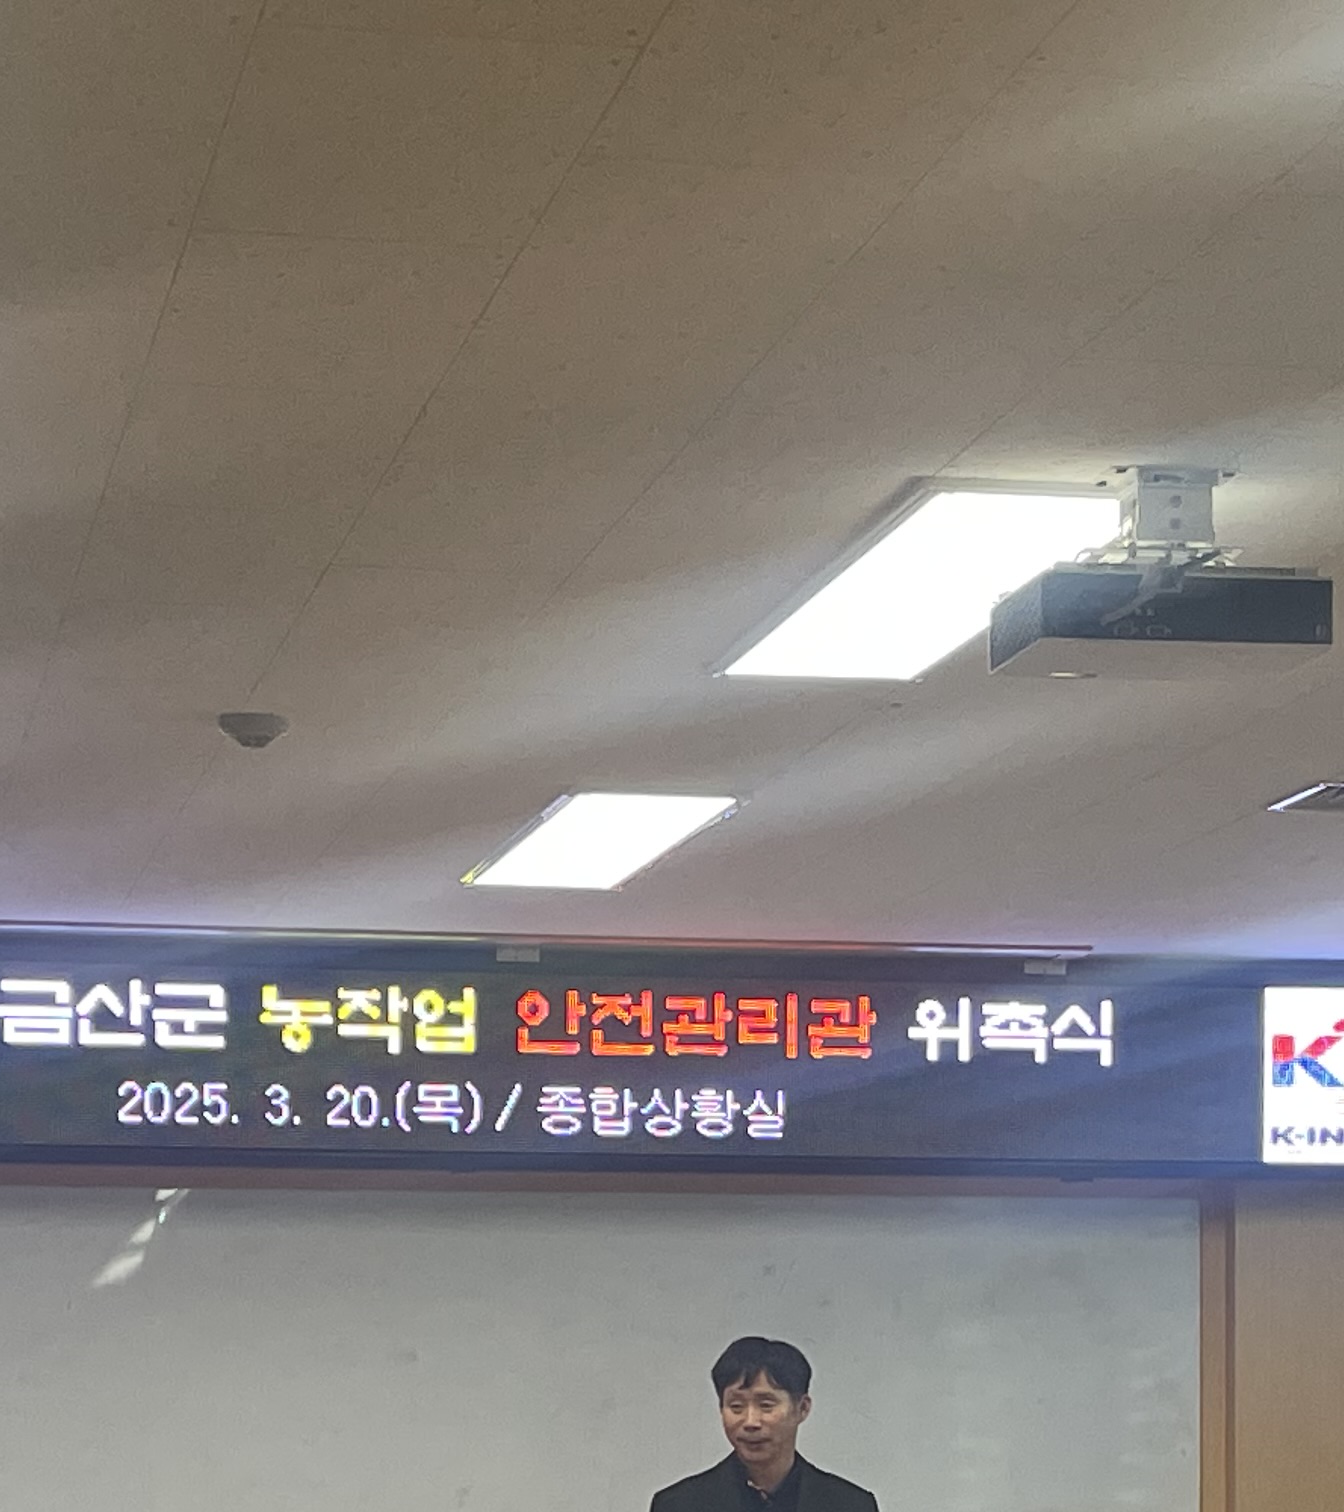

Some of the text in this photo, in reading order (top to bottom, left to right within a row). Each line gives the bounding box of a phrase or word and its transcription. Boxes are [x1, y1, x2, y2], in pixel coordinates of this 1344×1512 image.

[259, 985, 476, 1055] 농작업
[516, 987, 877, 1060] 안전관리관
[907, 997, 1115, 1067] 위촉식
[117, 1080, 241, 1126] 2025.
[264, 1083, 302, 1127] 3.
[325, 1080, 483, 1134] 20.(목)
[536, 1085, 786, 1140] 종합상황실
